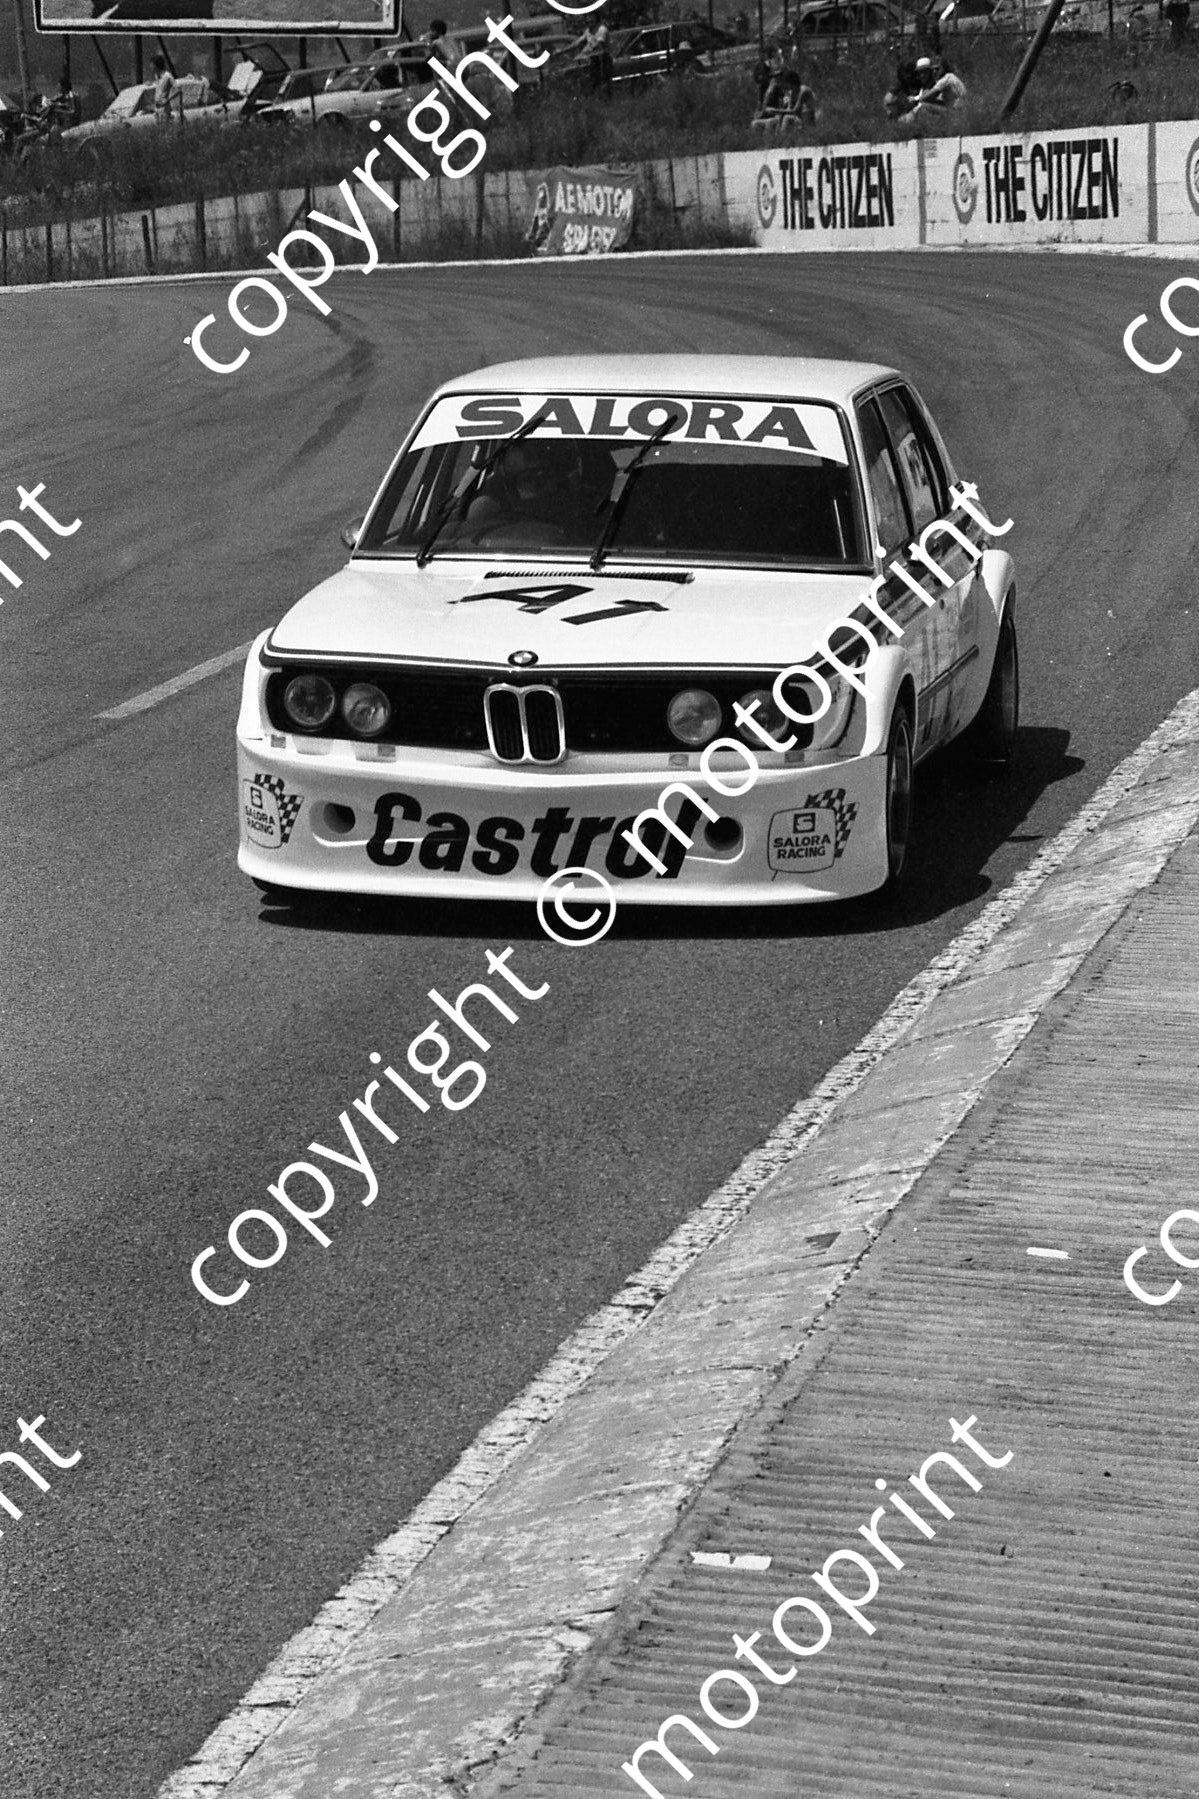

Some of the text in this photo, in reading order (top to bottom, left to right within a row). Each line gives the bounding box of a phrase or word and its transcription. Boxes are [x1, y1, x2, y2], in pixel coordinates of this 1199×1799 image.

[779, 158, 815, 230] THE
[818, 153, 895, 229] CITIZEN
[982, 145, 1027, 223] THE
[1030, 137, 1119, 221] CITIZEN
[455, 397, 818, 451] SALORA
[366, 792, 709, 879] Castrol
[773, 834, 832, 848] SALORA
[777, 846, 826, 859] RACING
